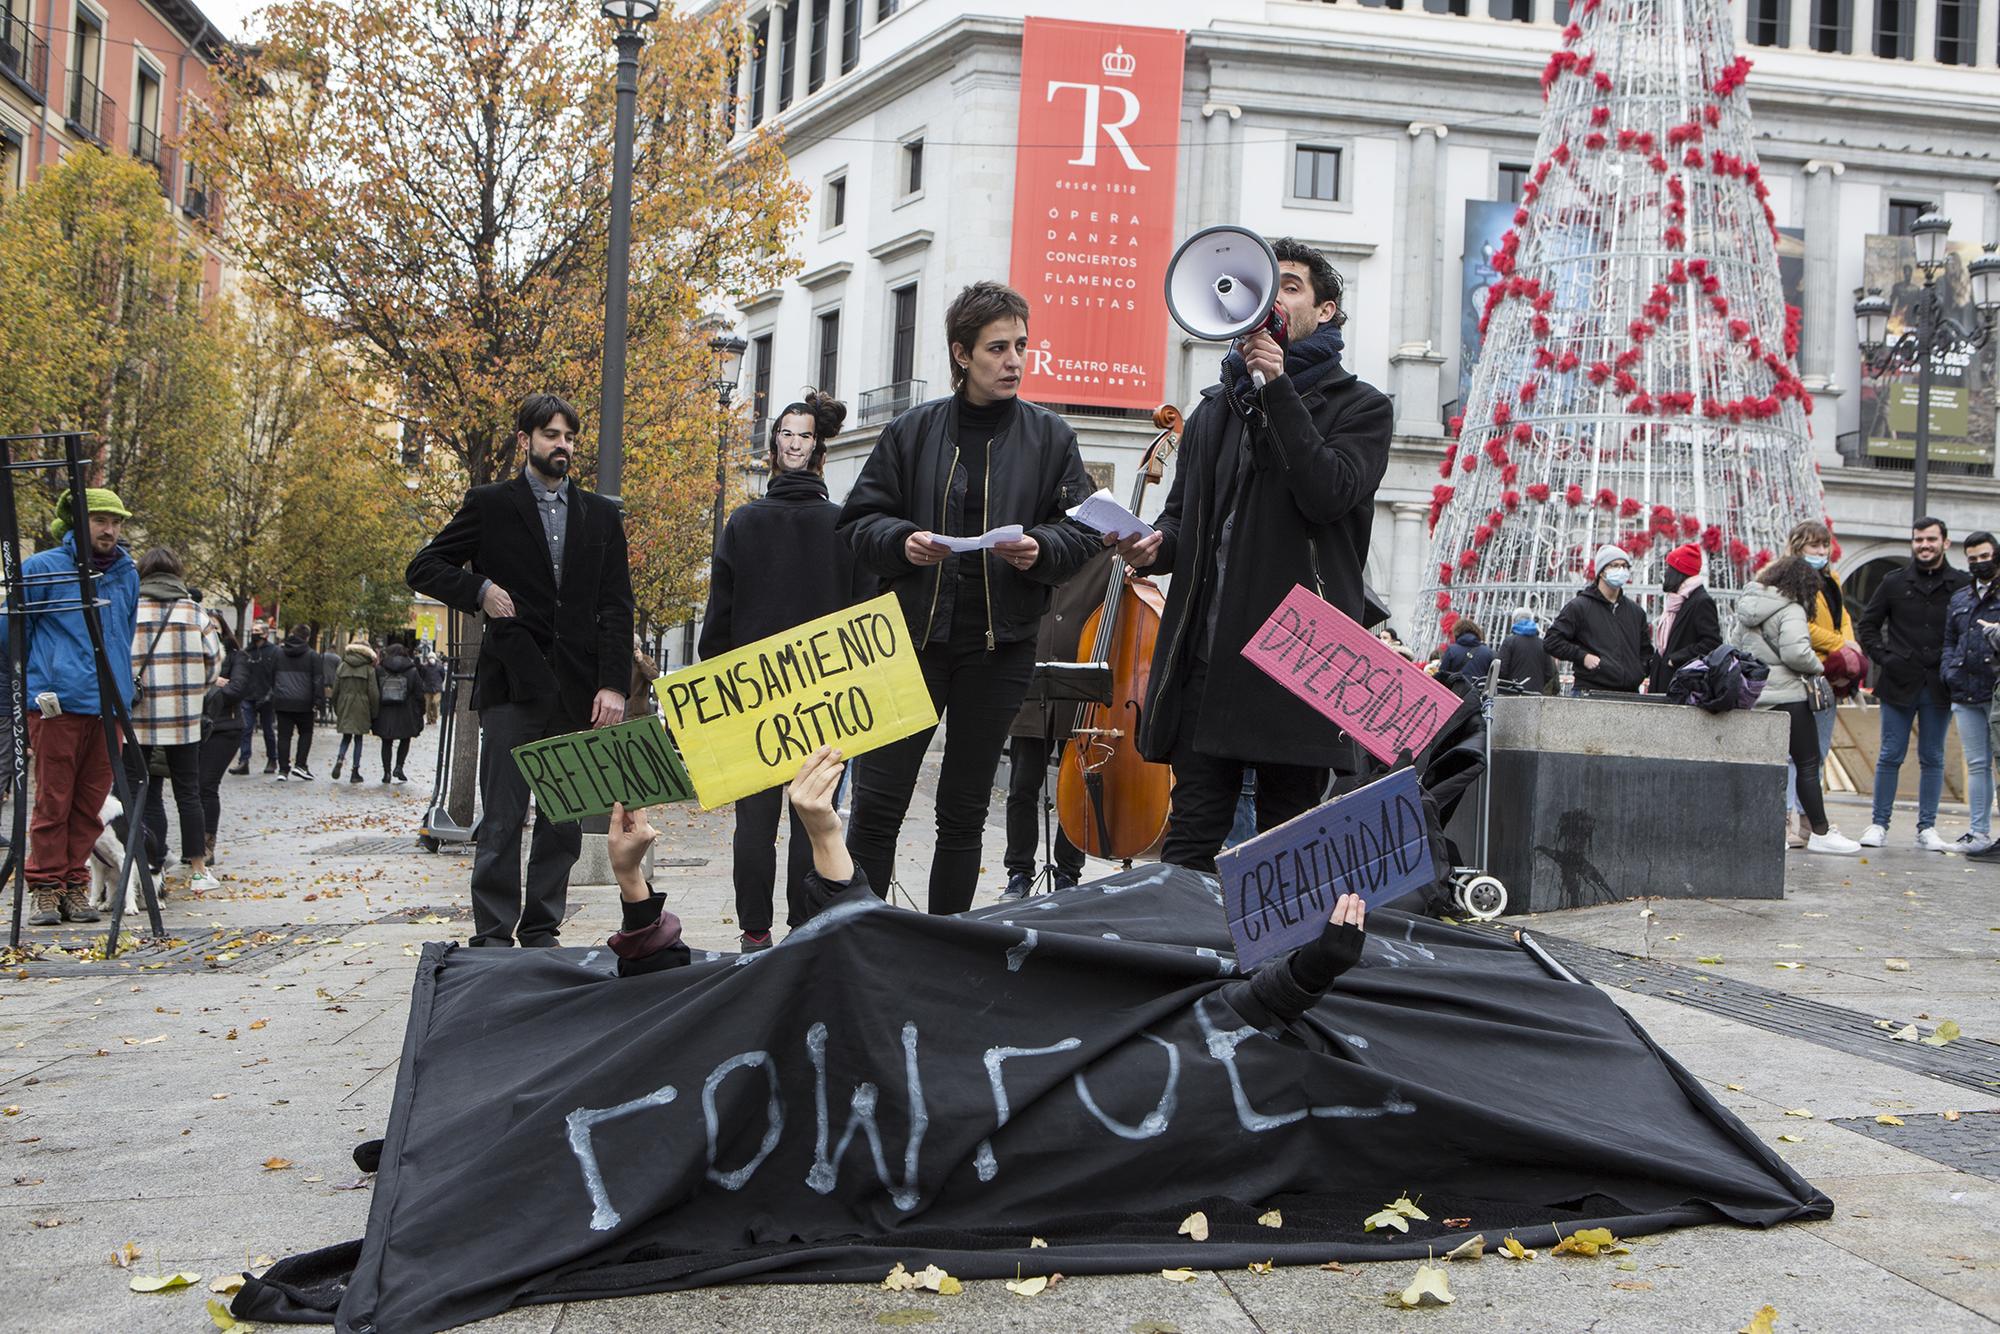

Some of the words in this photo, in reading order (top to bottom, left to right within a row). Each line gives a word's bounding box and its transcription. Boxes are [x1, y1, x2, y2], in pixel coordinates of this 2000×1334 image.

[1047, 80, 1151, 171] TR
[1056, 180, 1097, 191] desde
[1107, 183, 1136, 194] 1818
[1048, 207, 1140, 225] ÓPERA
[1047, 230, 1138, 247] DANZA
[1046, 251, 1137, 268] CONCIERTOS
[1044, 273, 1136, 289] FLAMENCO
[1044, 294, 1135, 310] VISITAS
[1058, 359, 1108, 372] TEATRO
[1112, 363, 1146, 375] REAL
[1056, 374, 1099, 383] CERCA
[667, 613, 897, 729] PENSAMIENTO
[1258, 606, 1439, 754] DIVERSIDAD
[755, 685, 874, 767] CRÍTICO
[520, 722, 688, 816] REFLEXIÓN
[1240, 794, 1422, 942] CREATIVIDAD
